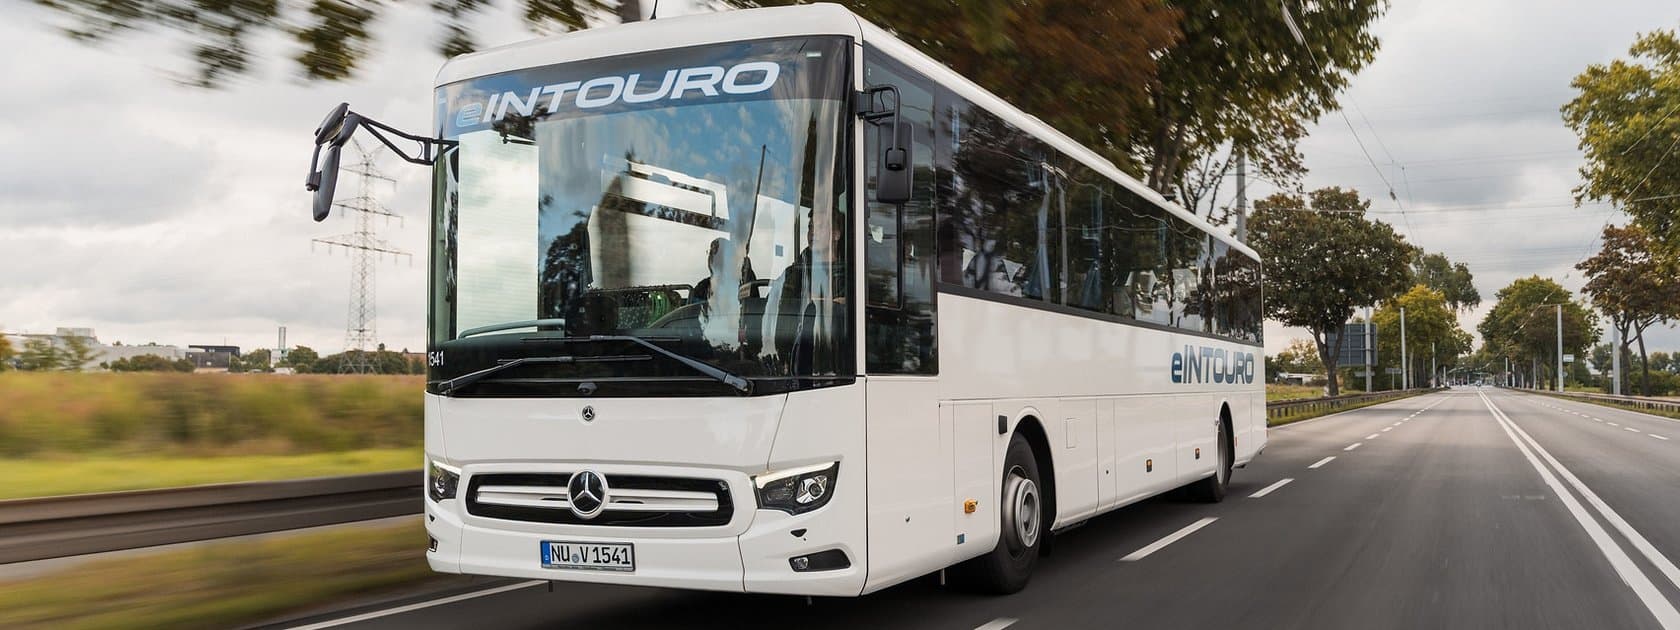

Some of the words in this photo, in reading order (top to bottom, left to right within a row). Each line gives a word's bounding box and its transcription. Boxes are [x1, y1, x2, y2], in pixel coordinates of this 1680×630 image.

[456, 61, 780, 127] eINTOURO
[1171, 344, 1254, 384] eINTOURO
[551, 545, 570, 562] NU
[580, 546, 589, 563] V
[592, 546, 630, 565] 1541
